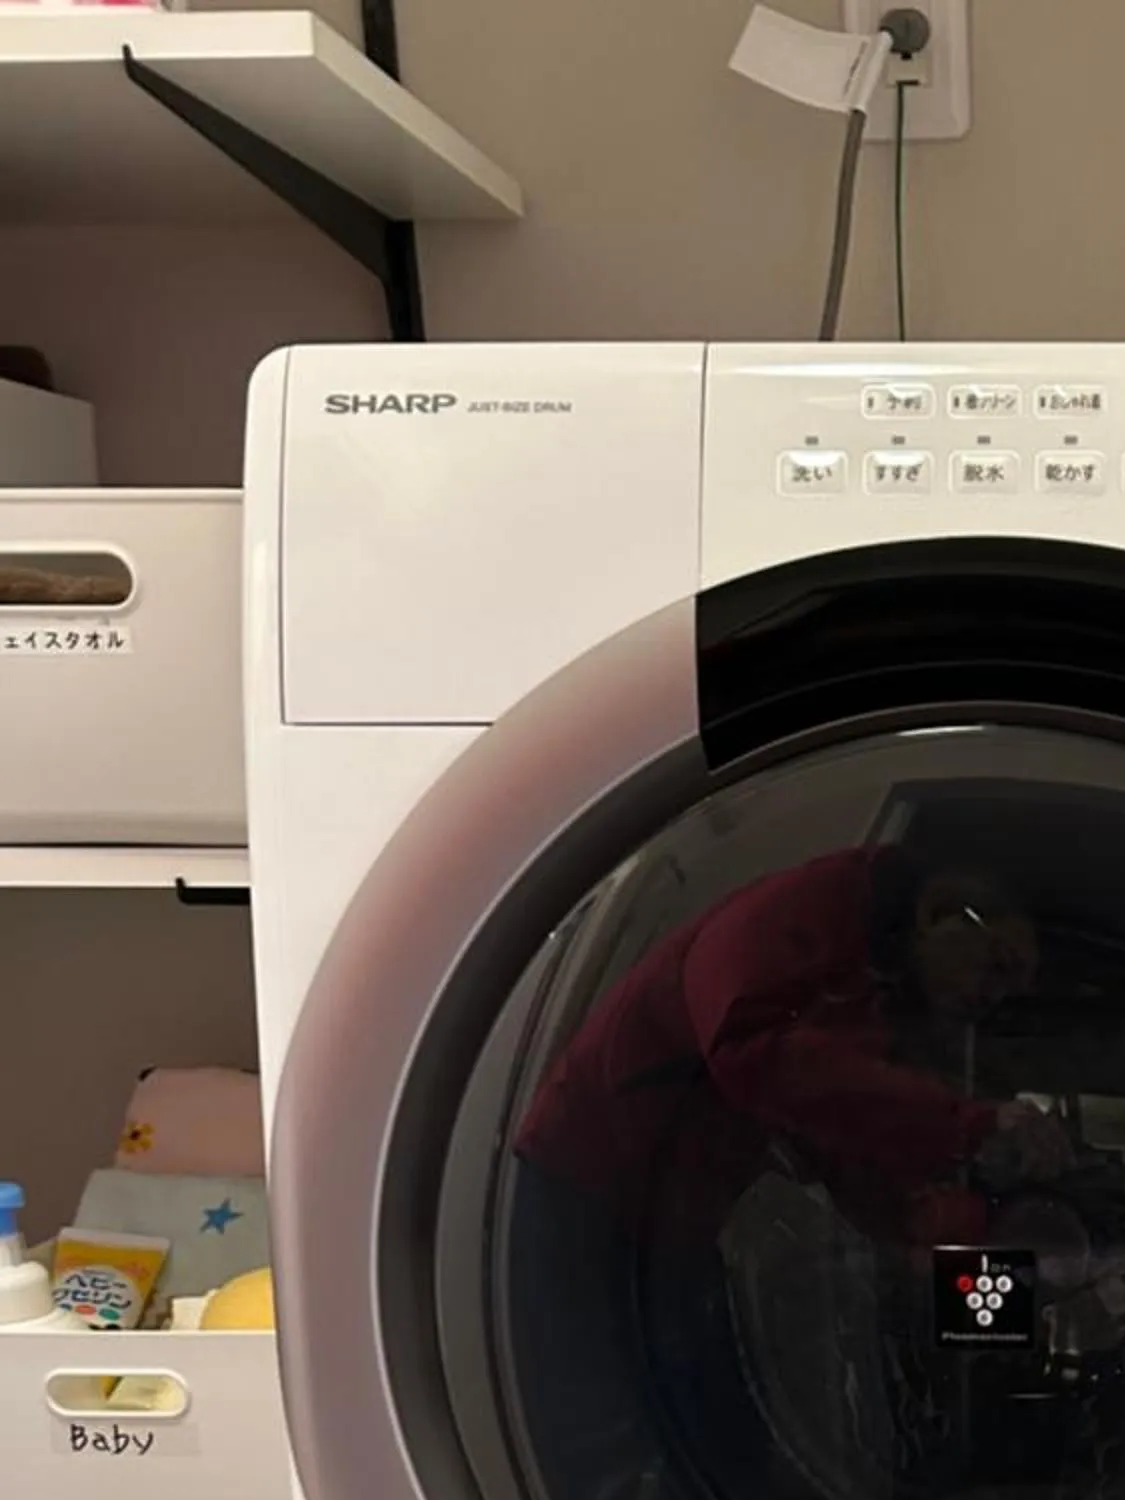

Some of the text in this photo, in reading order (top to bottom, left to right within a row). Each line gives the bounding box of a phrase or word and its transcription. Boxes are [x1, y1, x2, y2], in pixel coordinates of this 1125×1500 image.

[325, 394, 457, 414] SHARP
[874, 463, 922, 482] すすぎ
[963, 463, 1005, 482] 脱水
[1046, 463, 1095, 482] 乾かす
[69, 1423, 155, 1454] Baby
